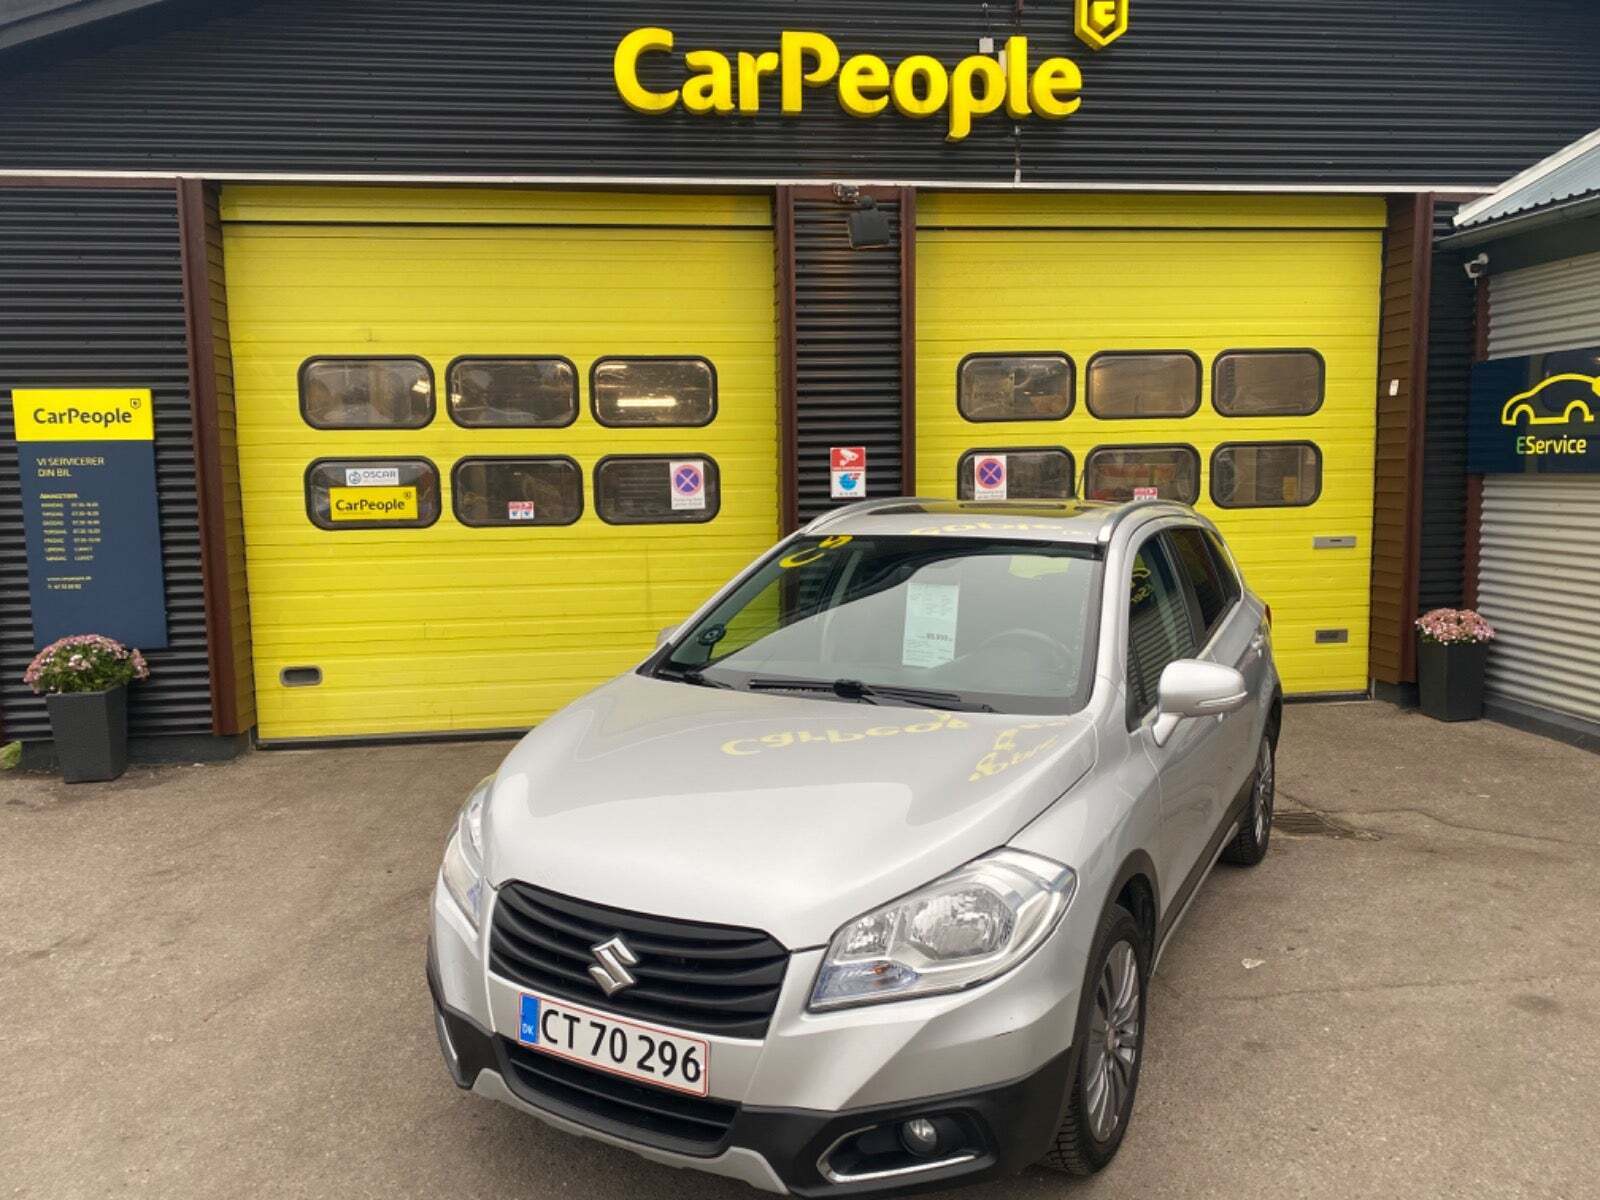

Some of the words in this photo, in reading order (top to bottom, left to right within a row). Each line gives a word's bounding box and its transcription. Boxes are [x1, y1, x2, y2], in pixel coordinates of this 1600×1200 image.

[614, 27, 1082, 141] CarPeople
[33, 407, 132, 428] CarPeople
[1516, 434, 1587, 455] EService
[38, 468, 55, 477] DIN
[57, 467, 72, 477] BIL
[363, 470, 396, 478] OSCAR
[335, 498, 405, 513] CarPeople
[521, 1022, 535, 1036] DK
[541, 1009, 580, 1050] CT
[590, 1021, 628, 1064] 70
[636, 1035, 702, 1083] 296
